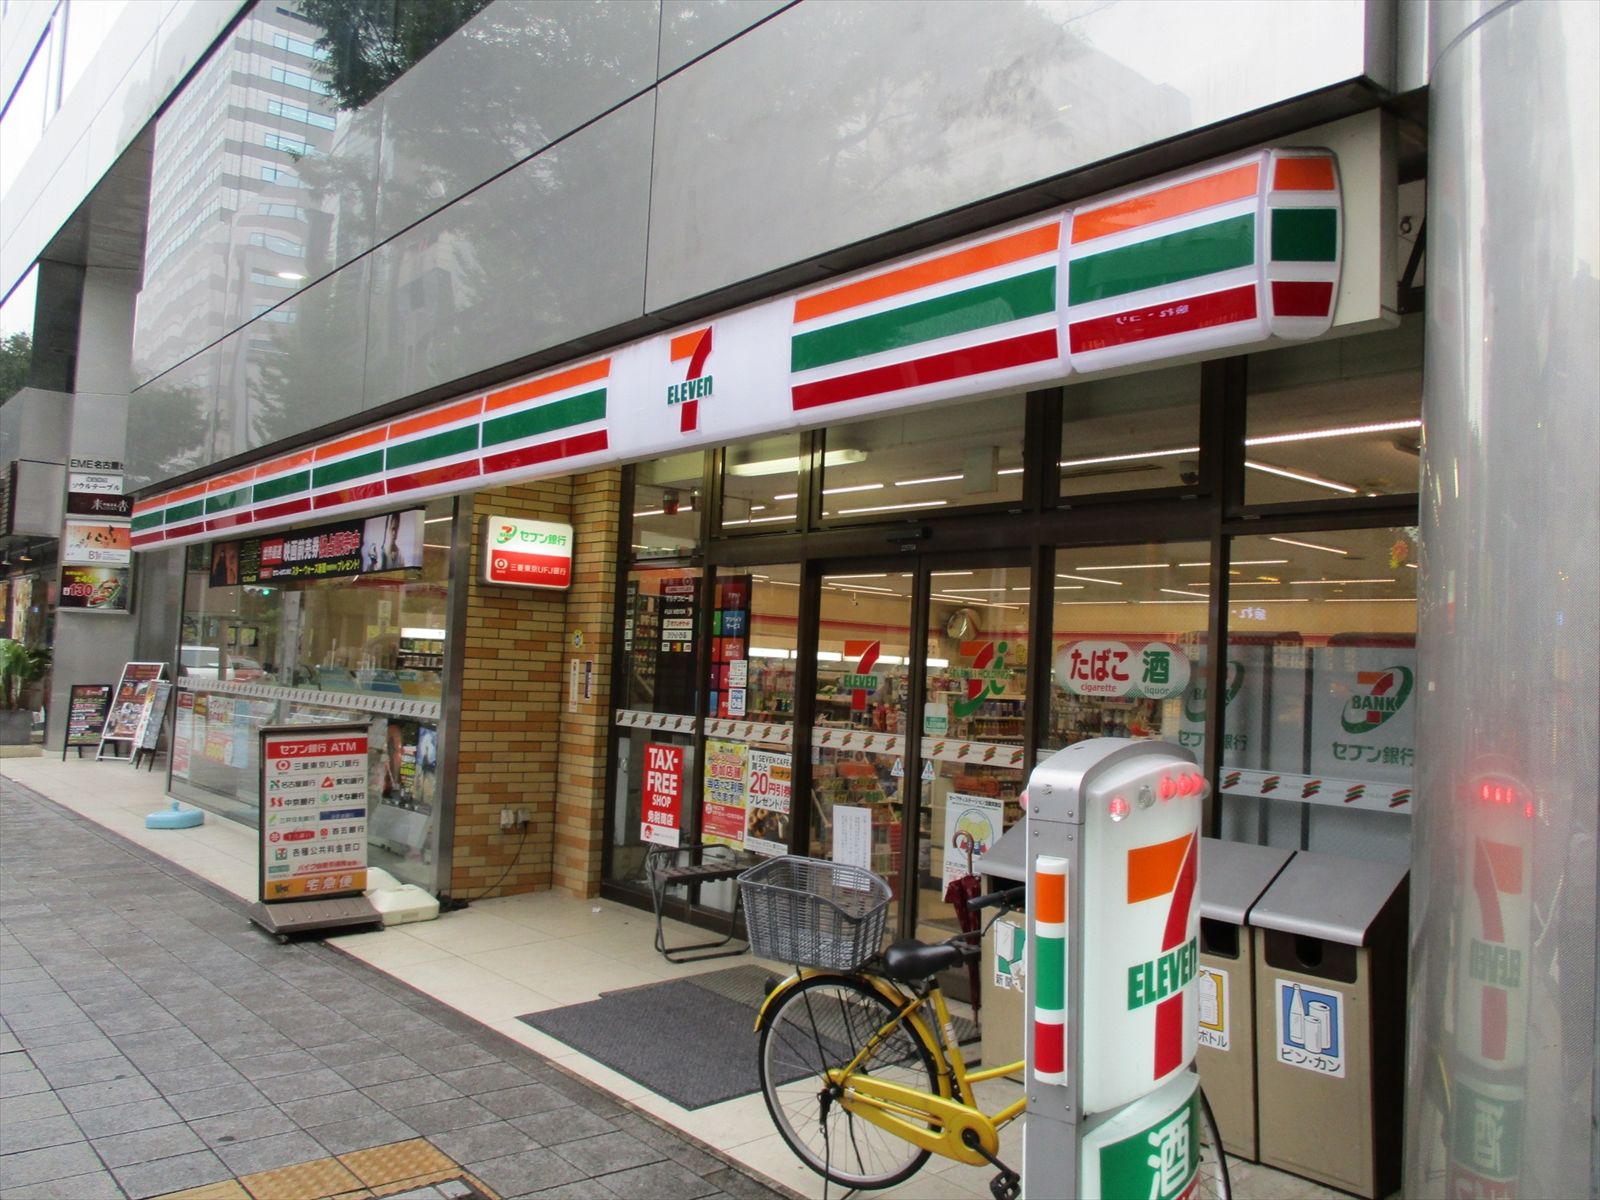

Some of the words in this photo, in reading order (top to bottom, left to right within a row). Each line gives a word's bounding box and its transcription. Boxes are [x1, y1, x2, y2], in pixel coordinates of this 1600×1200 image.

[520, 530, 567, 546] セブン銀行
[510, 563, 567, 576] 三菱東京UFJ銀行
[1070, 648, 1130, 682] たばこ
[1142, 650, 1171, 684] 酒
[1081, 683, 1117, 693] cigarette
[1144, 686, 1170, 695] liquor
[1352, 695, 1396, 712] BANK
[280, 744, 327, 755] セブン銀行
[331, 742, 357, 752] ATM
[1331, 741, 1415, 768] セブン銀行
[294, 759, 360, 770] 三菱東京UFJ銀行
[649, 747, 679, 771] TAX-
[281, 780, 316, 789] 名古屋銀行
[336, 777, 364, 786] 愛知銀行
[647, 770, 678, 796] FREE
[284, 798, 316, 807] 中京銀行
[331, 792, 365, 802] りそな銀行
[652, 794, 672, 808] SHOP
[749, 795, 783, 810] プレゼント!
[293, 843, 360, 858] 各種公共料金窓口
[306, 876, 353, 891] 宅急便
[1281, 1047, 1341, 1073] ビン・カン
[1147, 1106, 1190, 1200] 酒
